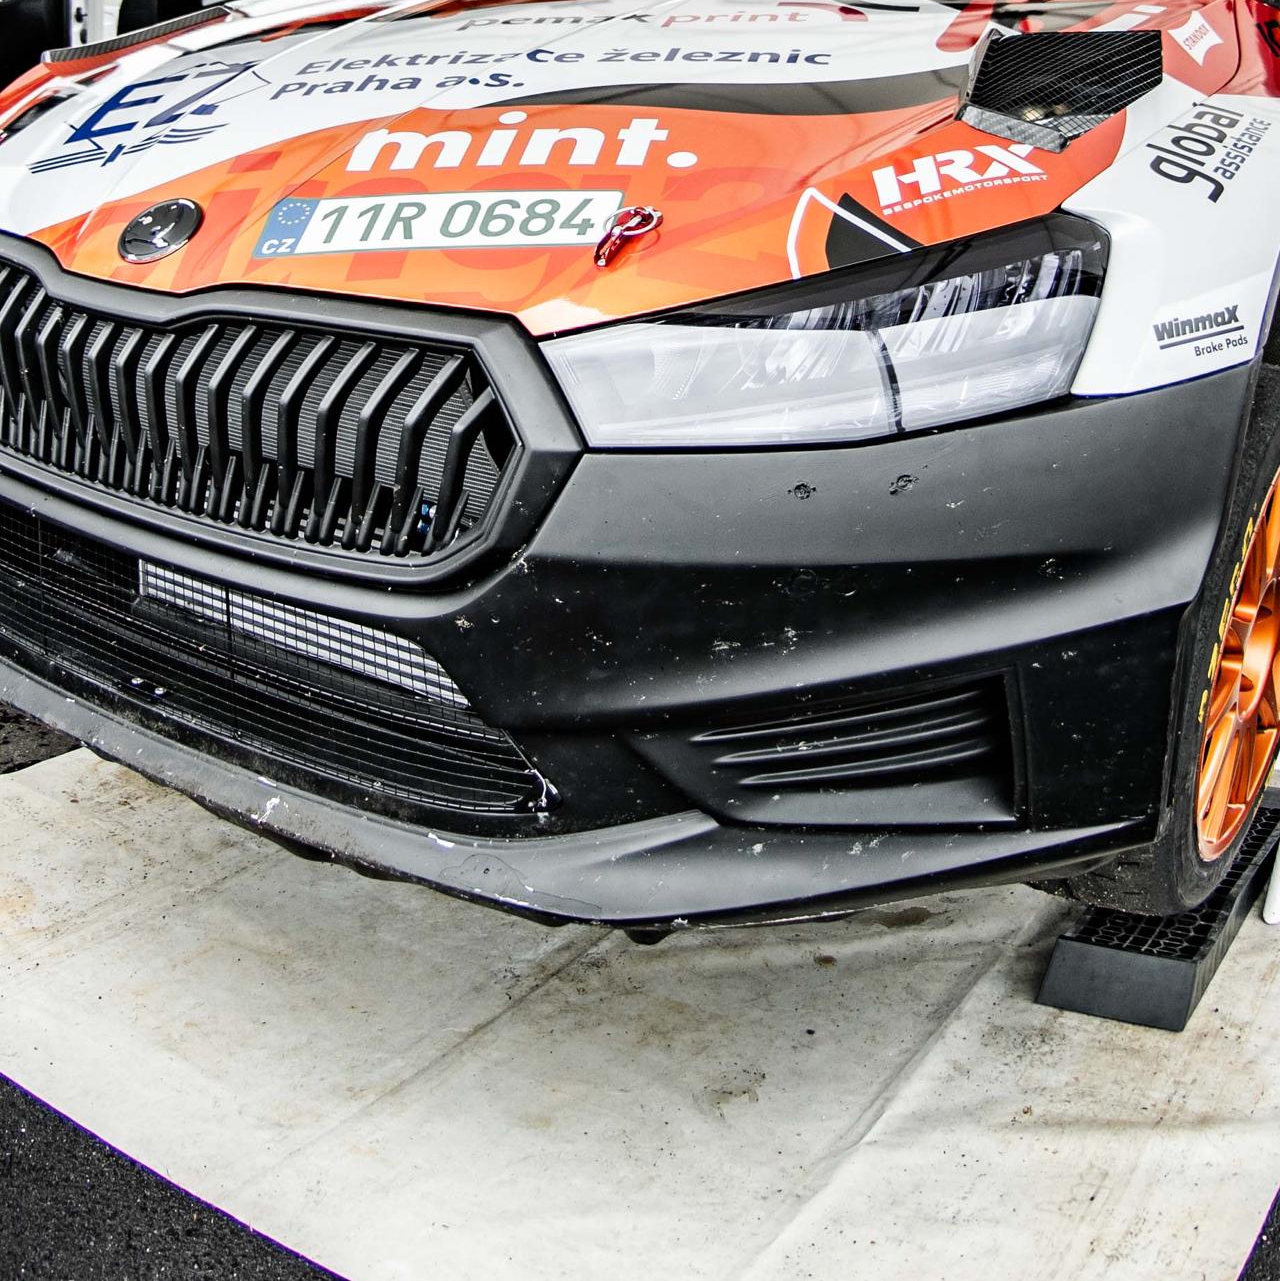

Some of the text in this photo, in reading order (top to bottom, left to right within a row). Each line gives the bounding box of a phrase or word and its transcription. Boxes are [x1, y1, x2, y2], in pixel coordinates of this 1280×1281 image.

[661, 11, 810, 28] print
[597, 46, 833, 67] železnic
[270, 74, 423, 101] Praha
[344, 110, 699, 172] mint.
[1145, 102, 1244, 203] global
[1213, 118, 1272, 180] assistance
[872, 143, 1046, 208] HRX
[882, 174, 1048, 216] BESPOKEMOTORSPORT
[319, 197, 596, 245] 11R 0684
[261, 239, 293, 256] CZ
[1194, 334, 1248, 357] Brake Pads
